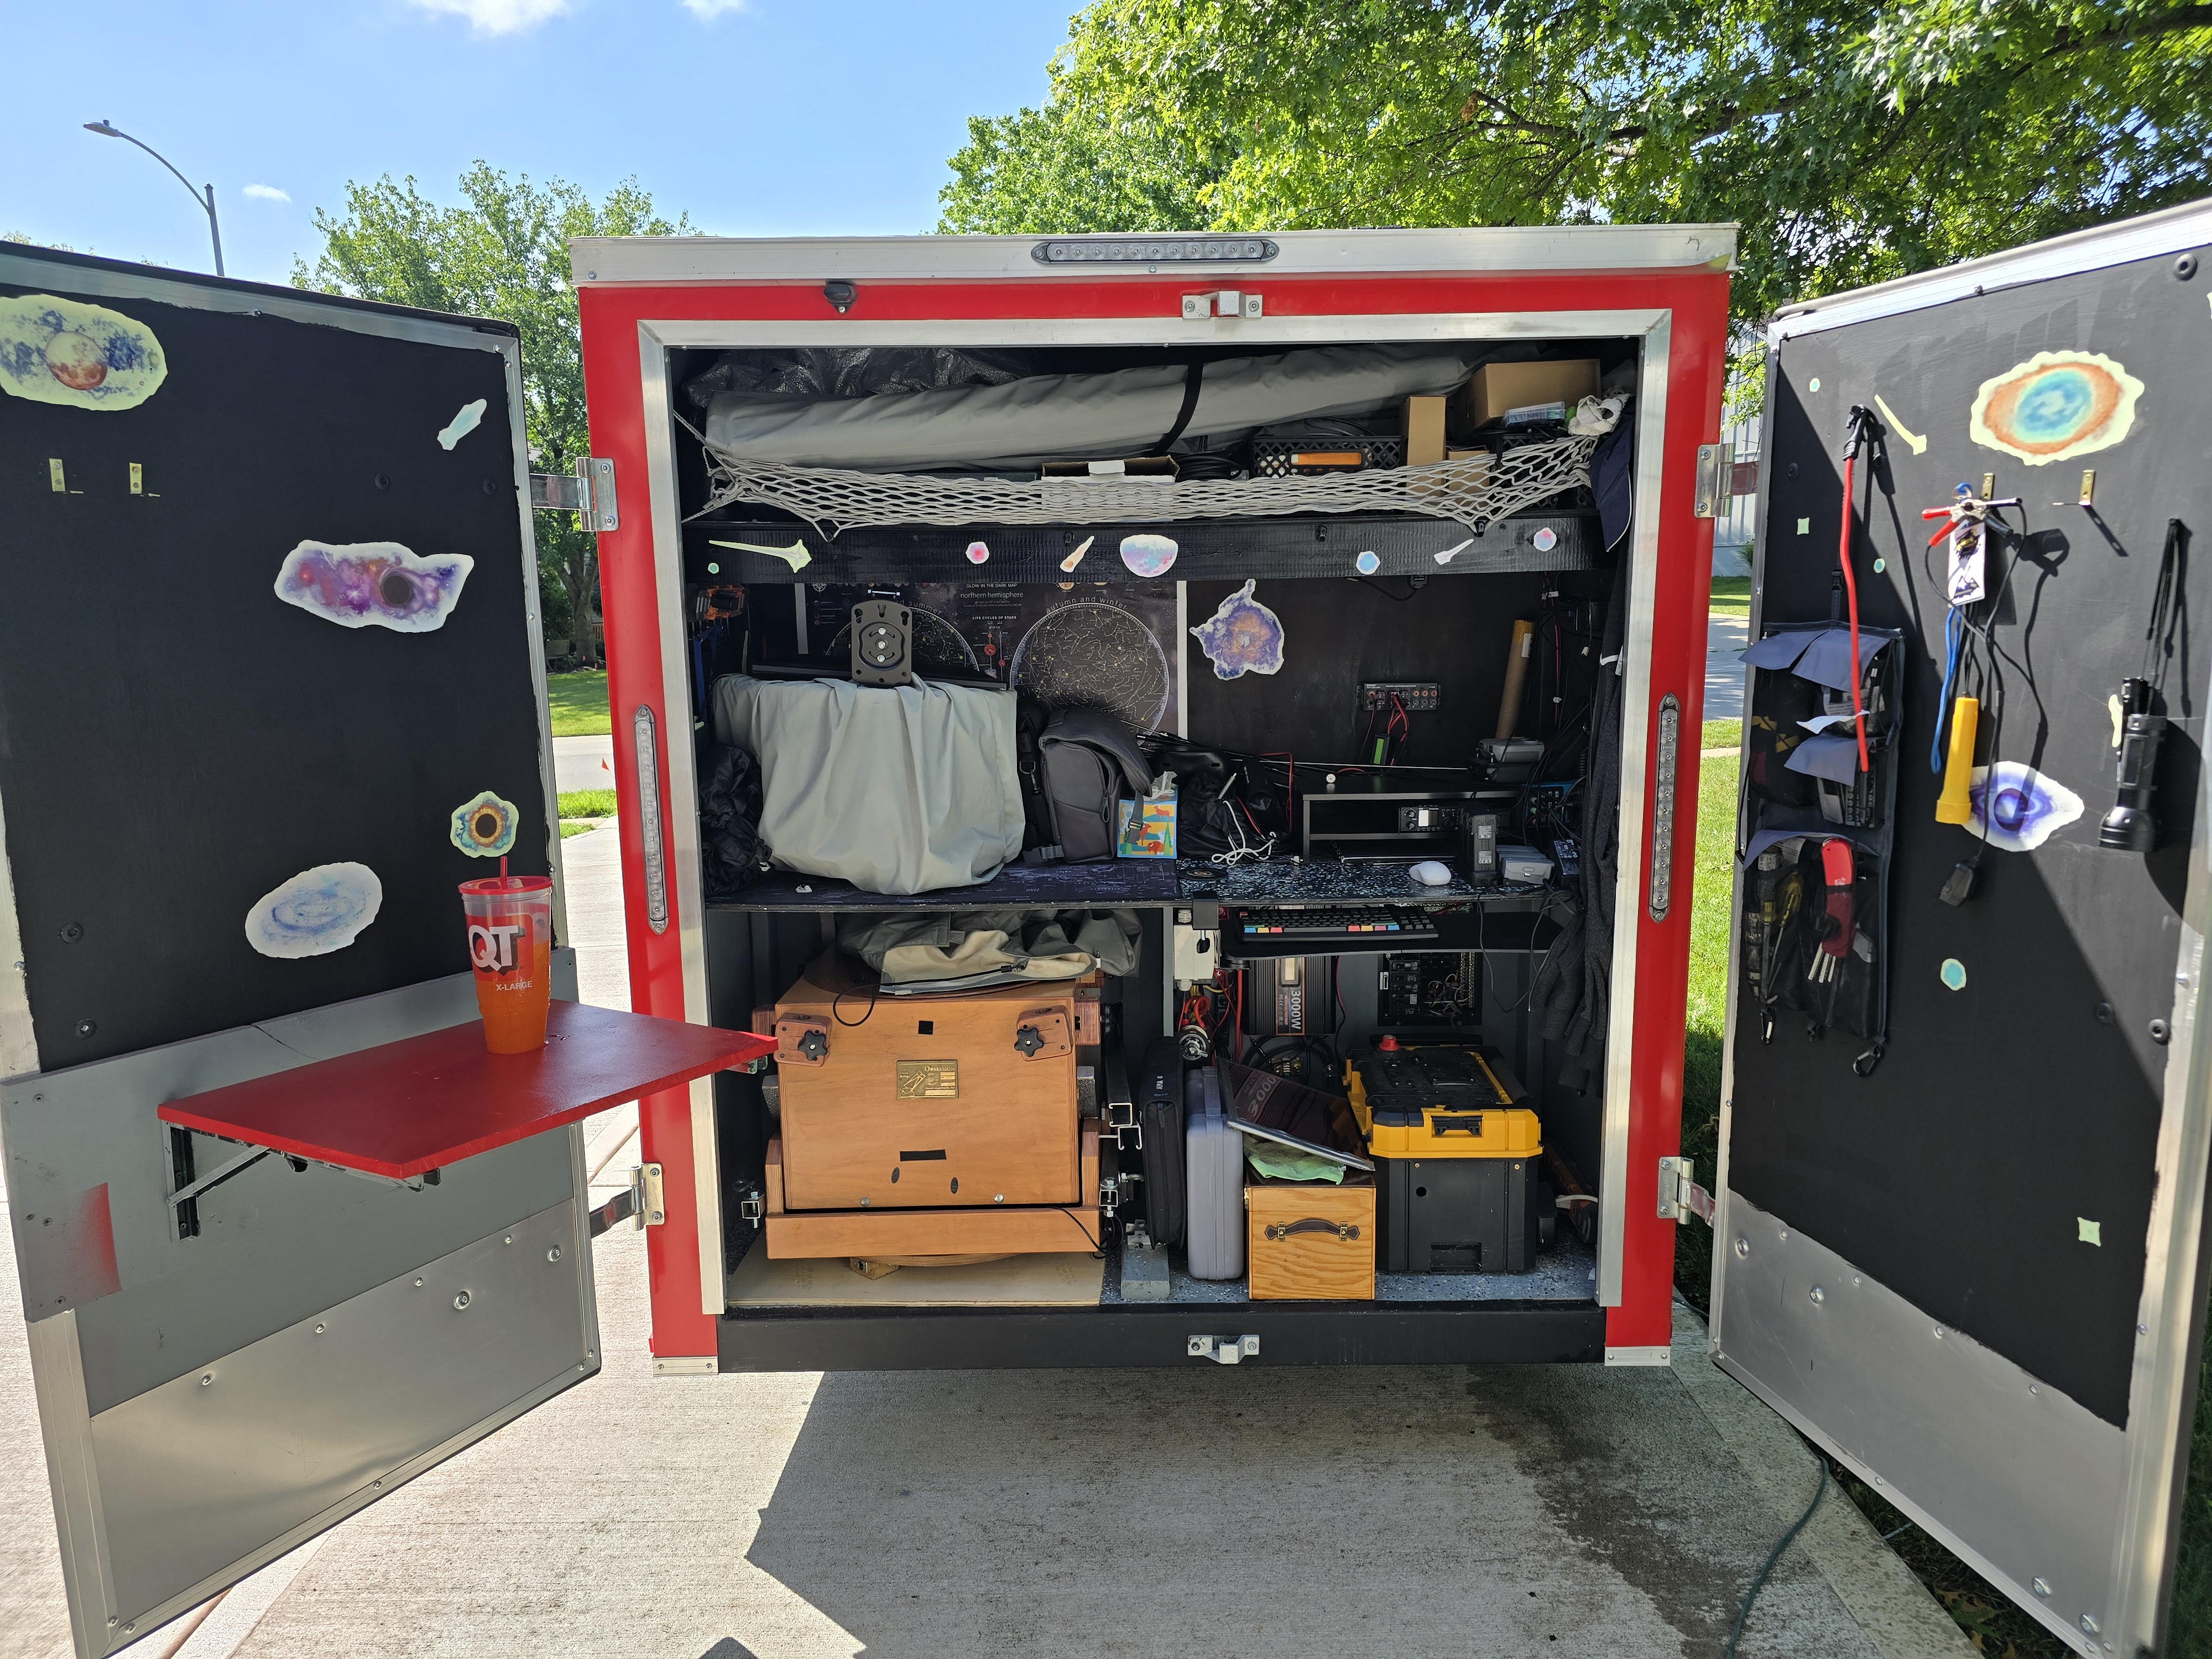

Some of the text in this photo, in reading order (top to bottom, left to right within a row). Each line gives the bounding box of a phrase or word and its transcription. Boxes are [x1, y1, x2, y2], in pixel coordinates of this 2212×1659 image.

[909, 601, 942, 615] summer
[1046, 597, 1076, 614] autumn
[1099, 597, 1127, 609] winter
[468, 925, 521, 973] QT
[495, 980, 533, 992] X-LARGE
[1291, 990, 1301, 1030] 3000W
